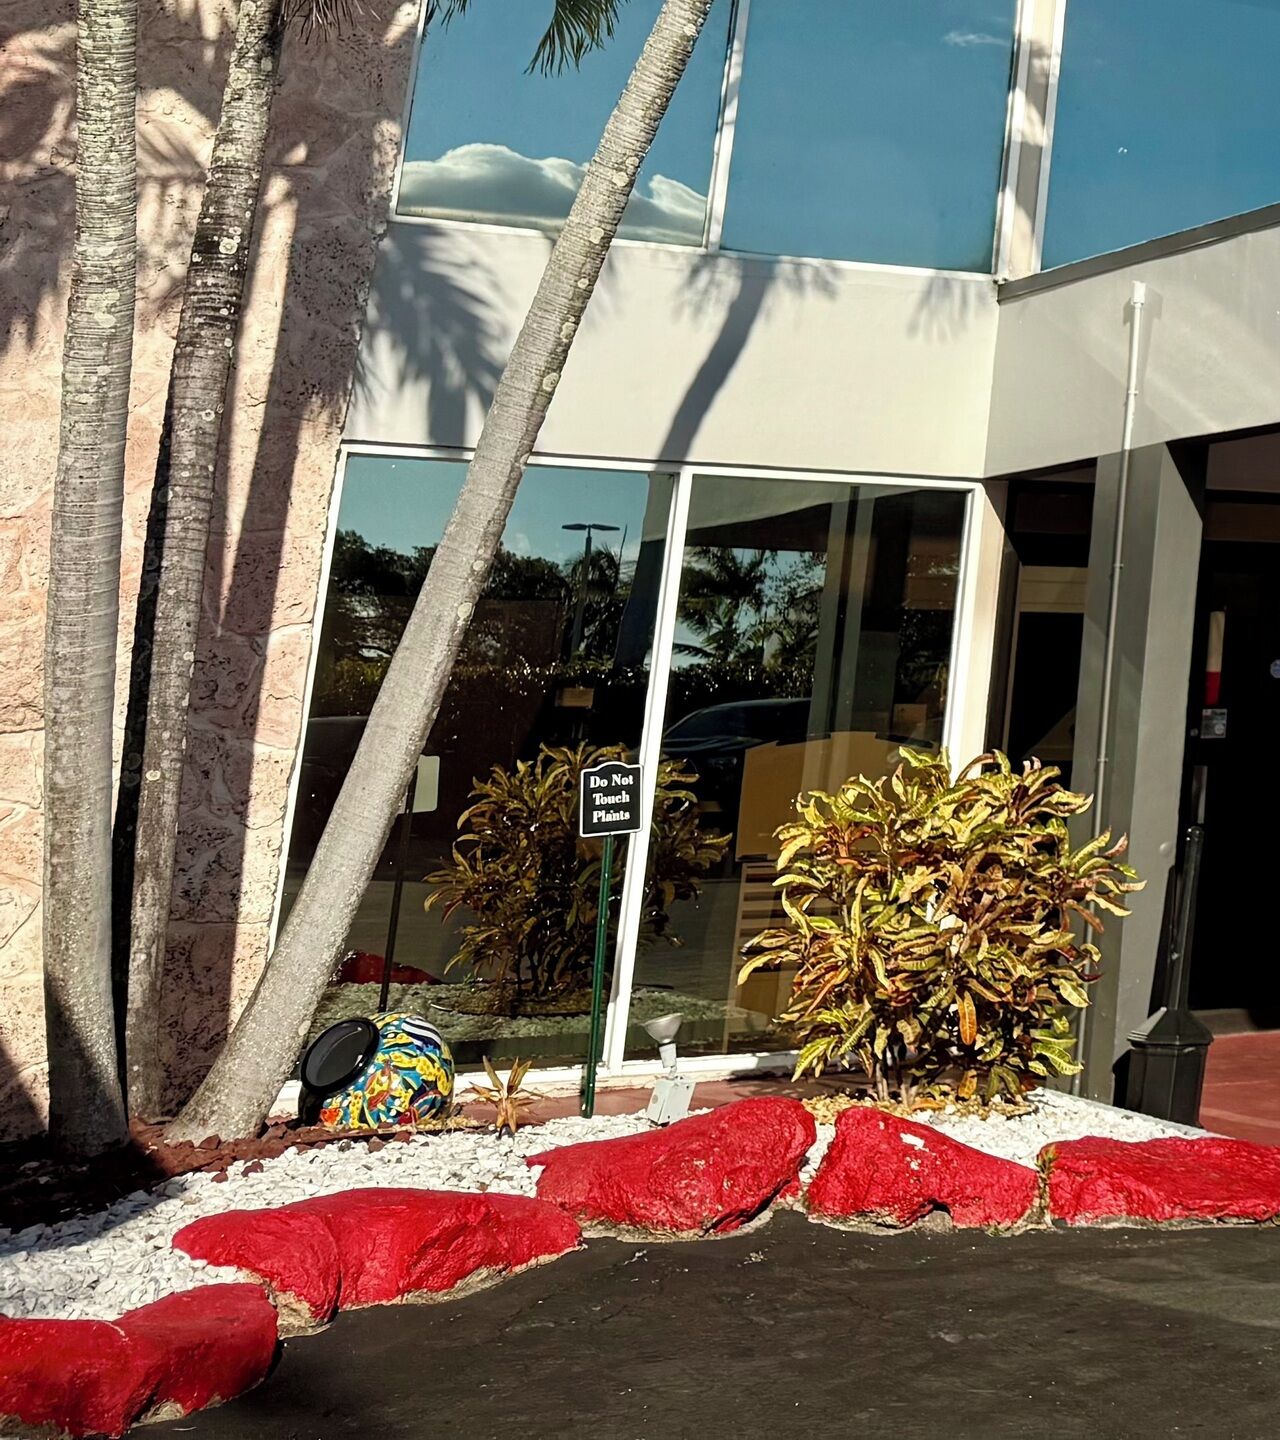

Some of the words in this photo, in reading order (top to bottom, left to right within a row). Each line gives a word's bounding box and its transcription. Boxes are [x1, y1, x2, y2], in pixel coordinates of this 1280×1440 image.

[590, 776, 608, 788] Do
[611, 774, 633, 786] Not
[592, 790, 630, 805] Touch
[592, 810, 630, 823] Plants
